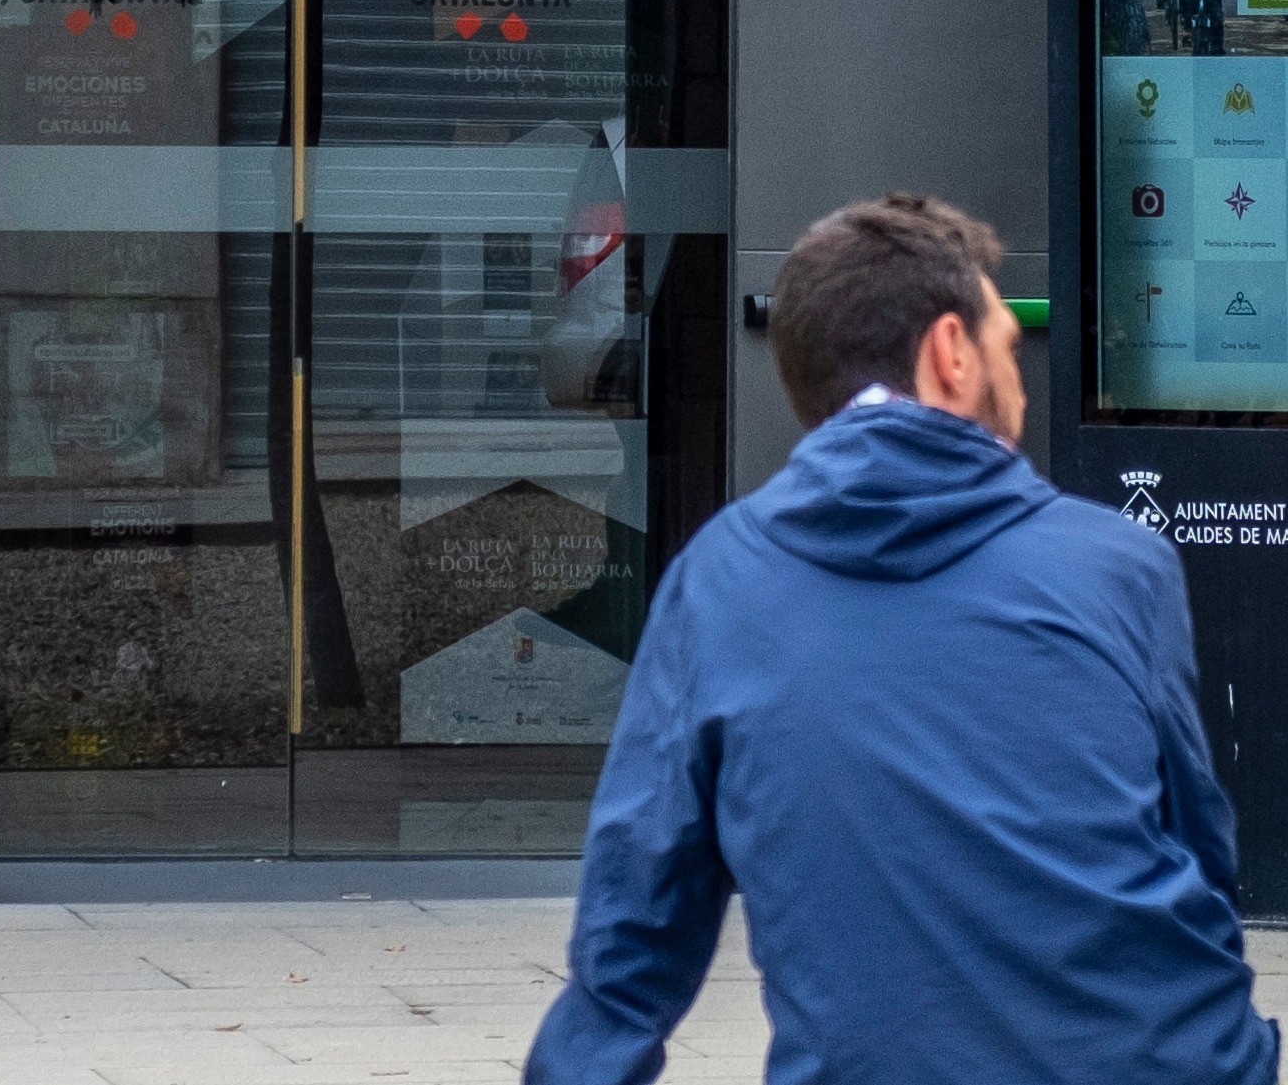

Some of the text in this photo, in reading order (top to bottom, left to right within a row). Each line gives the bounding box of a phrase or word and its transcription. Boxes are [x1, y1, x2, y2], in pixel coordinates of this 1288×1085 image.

[467, 47, 547, 63] LA RUTA
[24, 74, 147, 95] EMOCIONES
[37, 115, 133, 135] CATALUÑA
[1173, 502, 1286, 522] AJUNTAMENT
[90, 517, 177, 537] EMOTIONS
[1174, 526, 1233, 544] CALDES
[1241, 527, 1260, 545] DE
[442, 538, 514, 554] LA RUTA
[531, 534, 606, 550] LA RUTA
[439, 555, 514, 577] DOLÇA
[531, 562, 635, 579] BOTIFARRA
